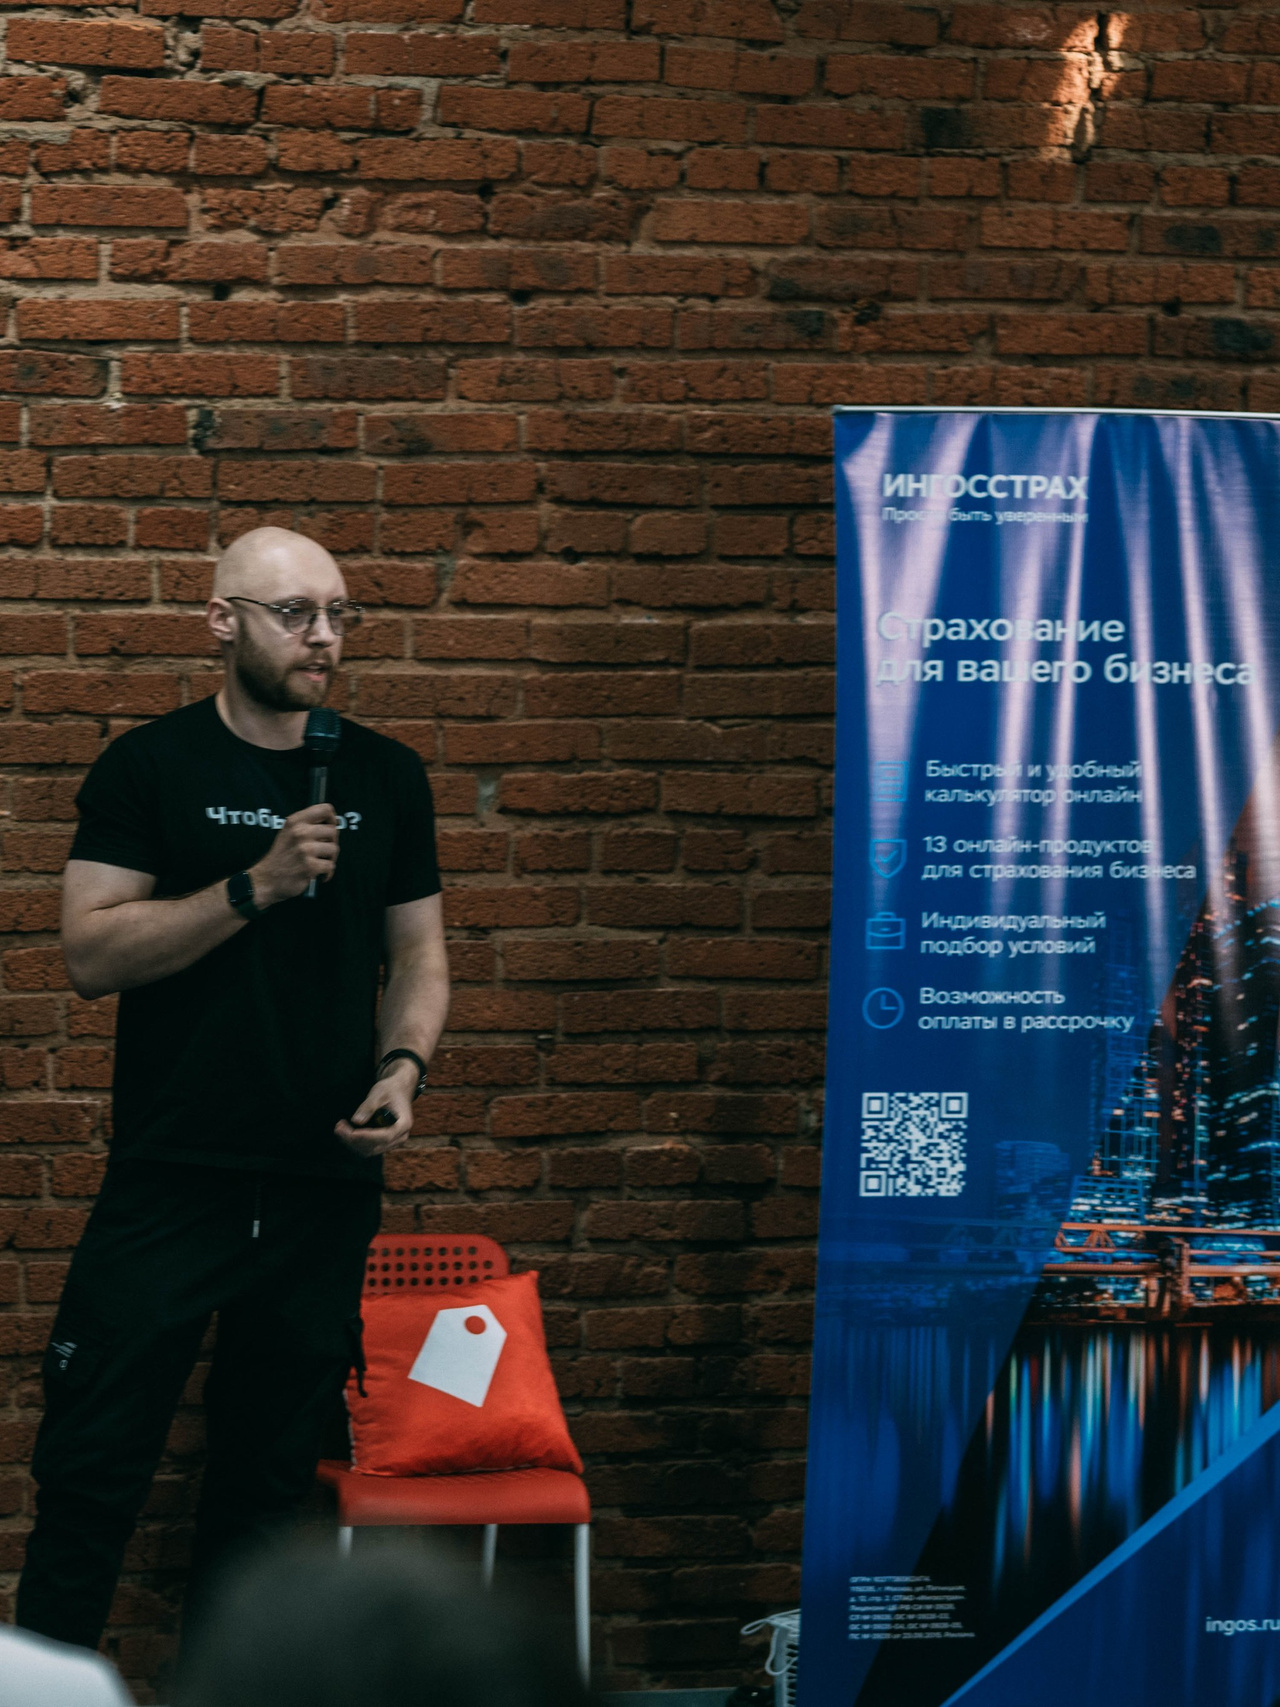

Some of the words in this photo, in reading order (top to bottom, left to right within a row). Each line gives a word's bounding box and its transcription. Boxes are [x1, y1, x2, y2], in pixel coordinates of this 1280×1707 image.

[882, 473, 1089, 500] ИНГОССТРАХ
[950, 507, 993, 522] быть
[994, 511, 1089, 525] уверенным
[877, 611, 1126, 648] Страхование
[876, 659, 944, 686] для
[956, 659, 1093, 684] вашего
[1103, 653, 1257, 686] бизнеса
[925, 760, 1022, 781] Быстрый
[1027, 764, 1042, 778] и
[1046, 760, 1142, 782] удобный
[924, 788, 1058, 807] калькулятор
[1062, 785, 1144, 803] онлайн
[922, 835, 947, 853] 13
[952, 836, 1153, 858] онлайн-продуктов
[921, 863, 963, 881] для
[968, 863, 1104, 882] страхования
[1108, 860, 1198, 880] бизнеса
[920, 911, 1107, 933] Индивидуальный
[920, 937, 1005, 956] подбор
[1007, 936, 1096, 957] условий
[919, 987, 1066, 1006] Возможность
[918, 1015, 999, 1031] оплаты
[1003, 1016, 1016, 1030] в
[1020, 1014, 1135, 1033] рассрочку
[1205, 1616, 1280, 1636] ingos.ru
